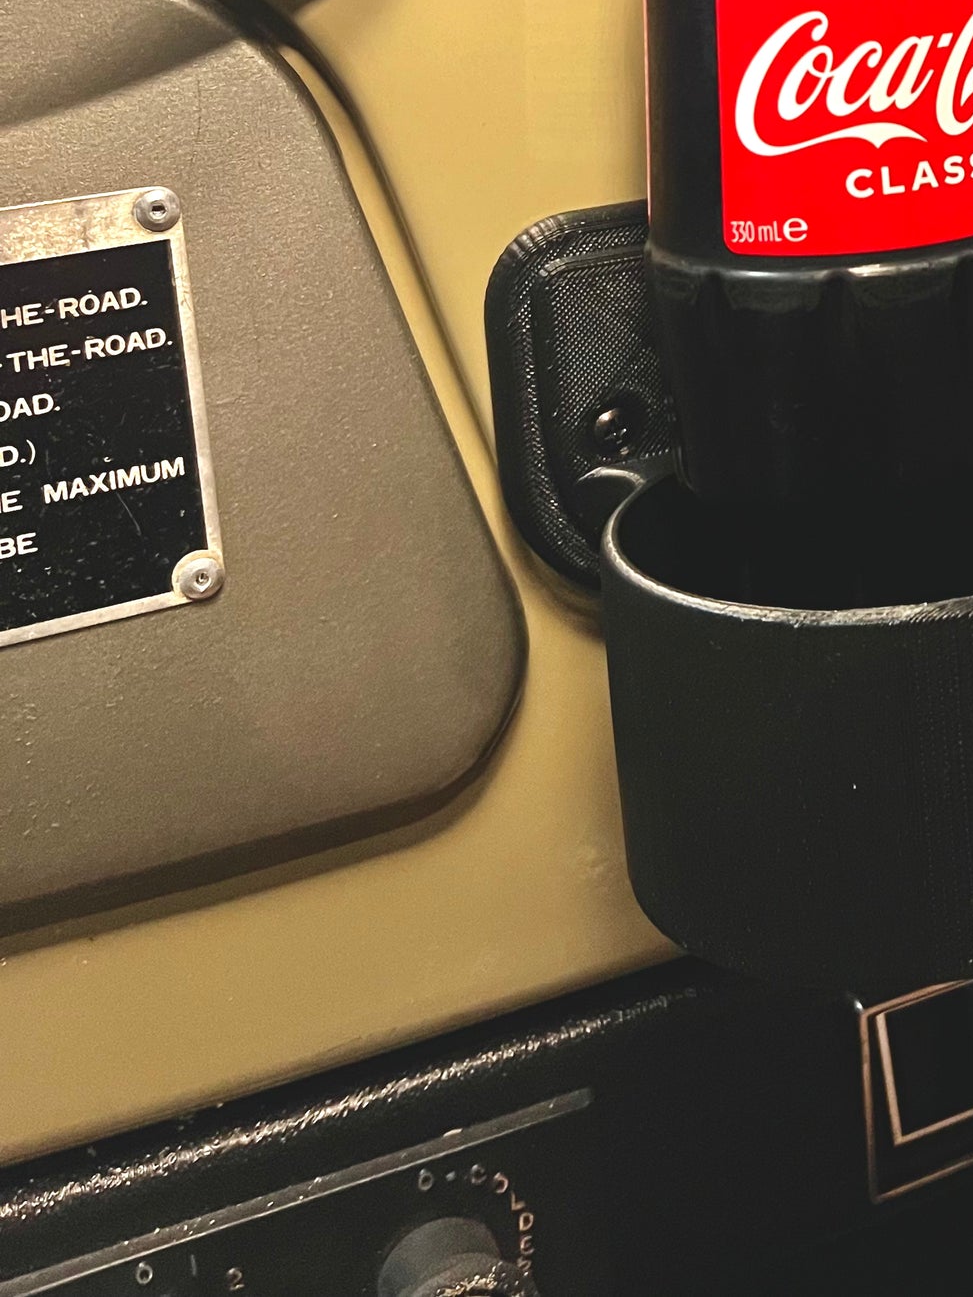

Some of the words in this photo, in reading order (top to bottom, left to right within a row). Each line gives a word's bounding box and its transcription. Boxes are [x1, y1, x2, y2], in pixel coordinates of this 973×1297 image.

[730, 220, 755, 243] 330
[0, 489, 24, 514] E
[42, 456, 186, 505] MAXIMUM
[0, 532, 39, 560] BE
[225, 1266, 246, 1292] 2
